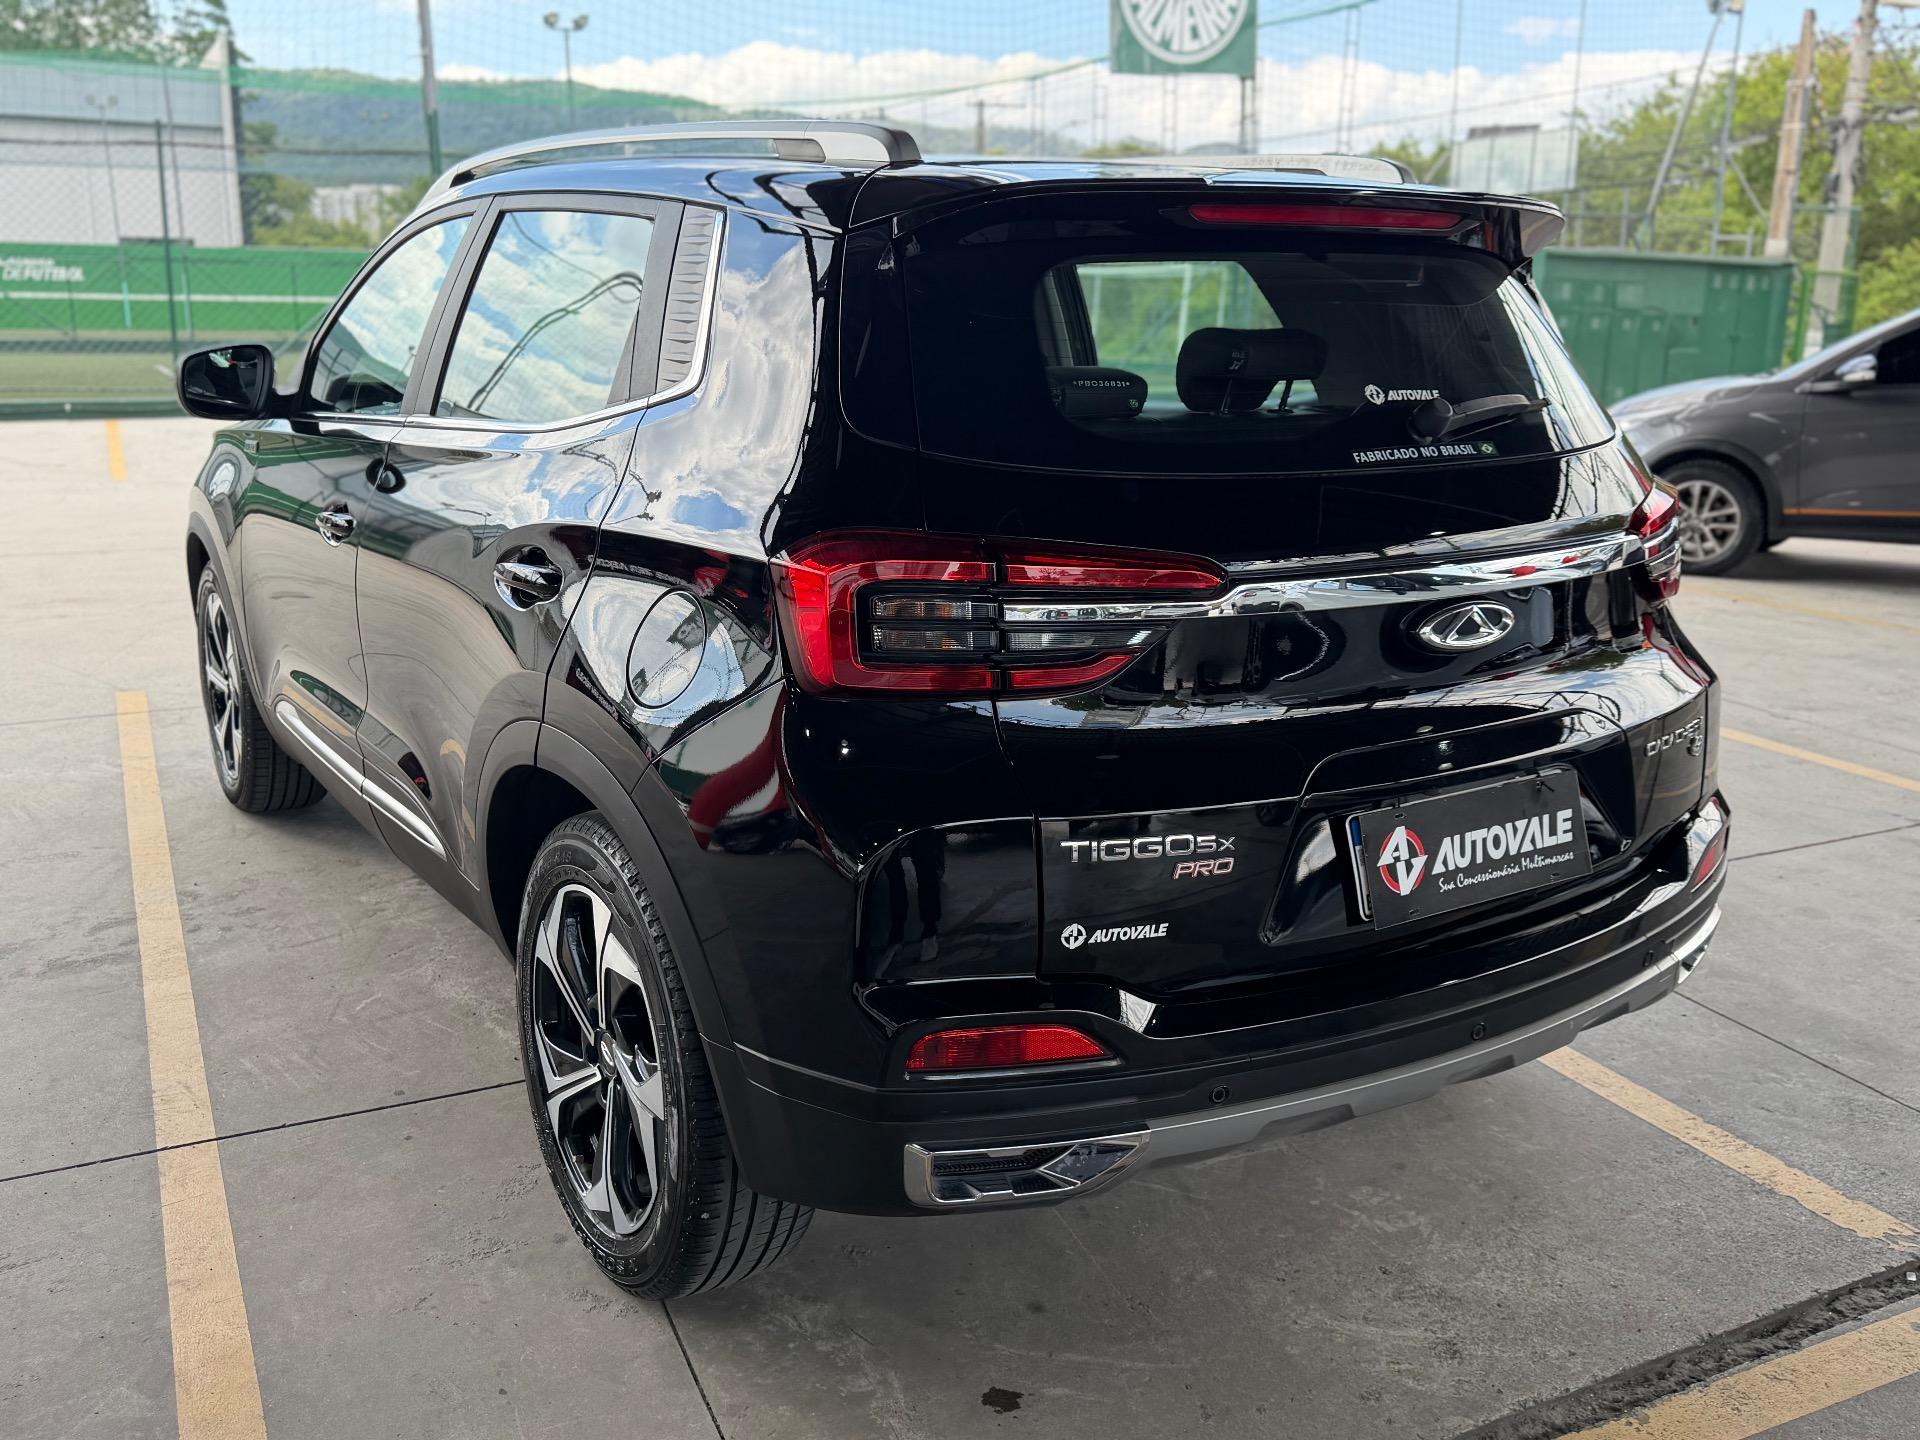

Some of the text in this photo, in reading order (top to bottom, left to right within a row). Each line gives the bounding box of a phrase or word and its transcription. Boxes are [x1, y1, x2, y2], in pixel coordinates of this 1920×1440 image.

[1387, 389, 1440, 400] AUTOVALE
[1353, 444, 1477, 463] FABRICADO NO BRASIL
[1432, 808, 1573, 875] AUTOVALE
[1172, 857, 1235, 880] PRO
[1439, 852, 1574, 893] Sua Concessionária Multimarcas
[1088, 923, 1169, 944] AUTOVALE
